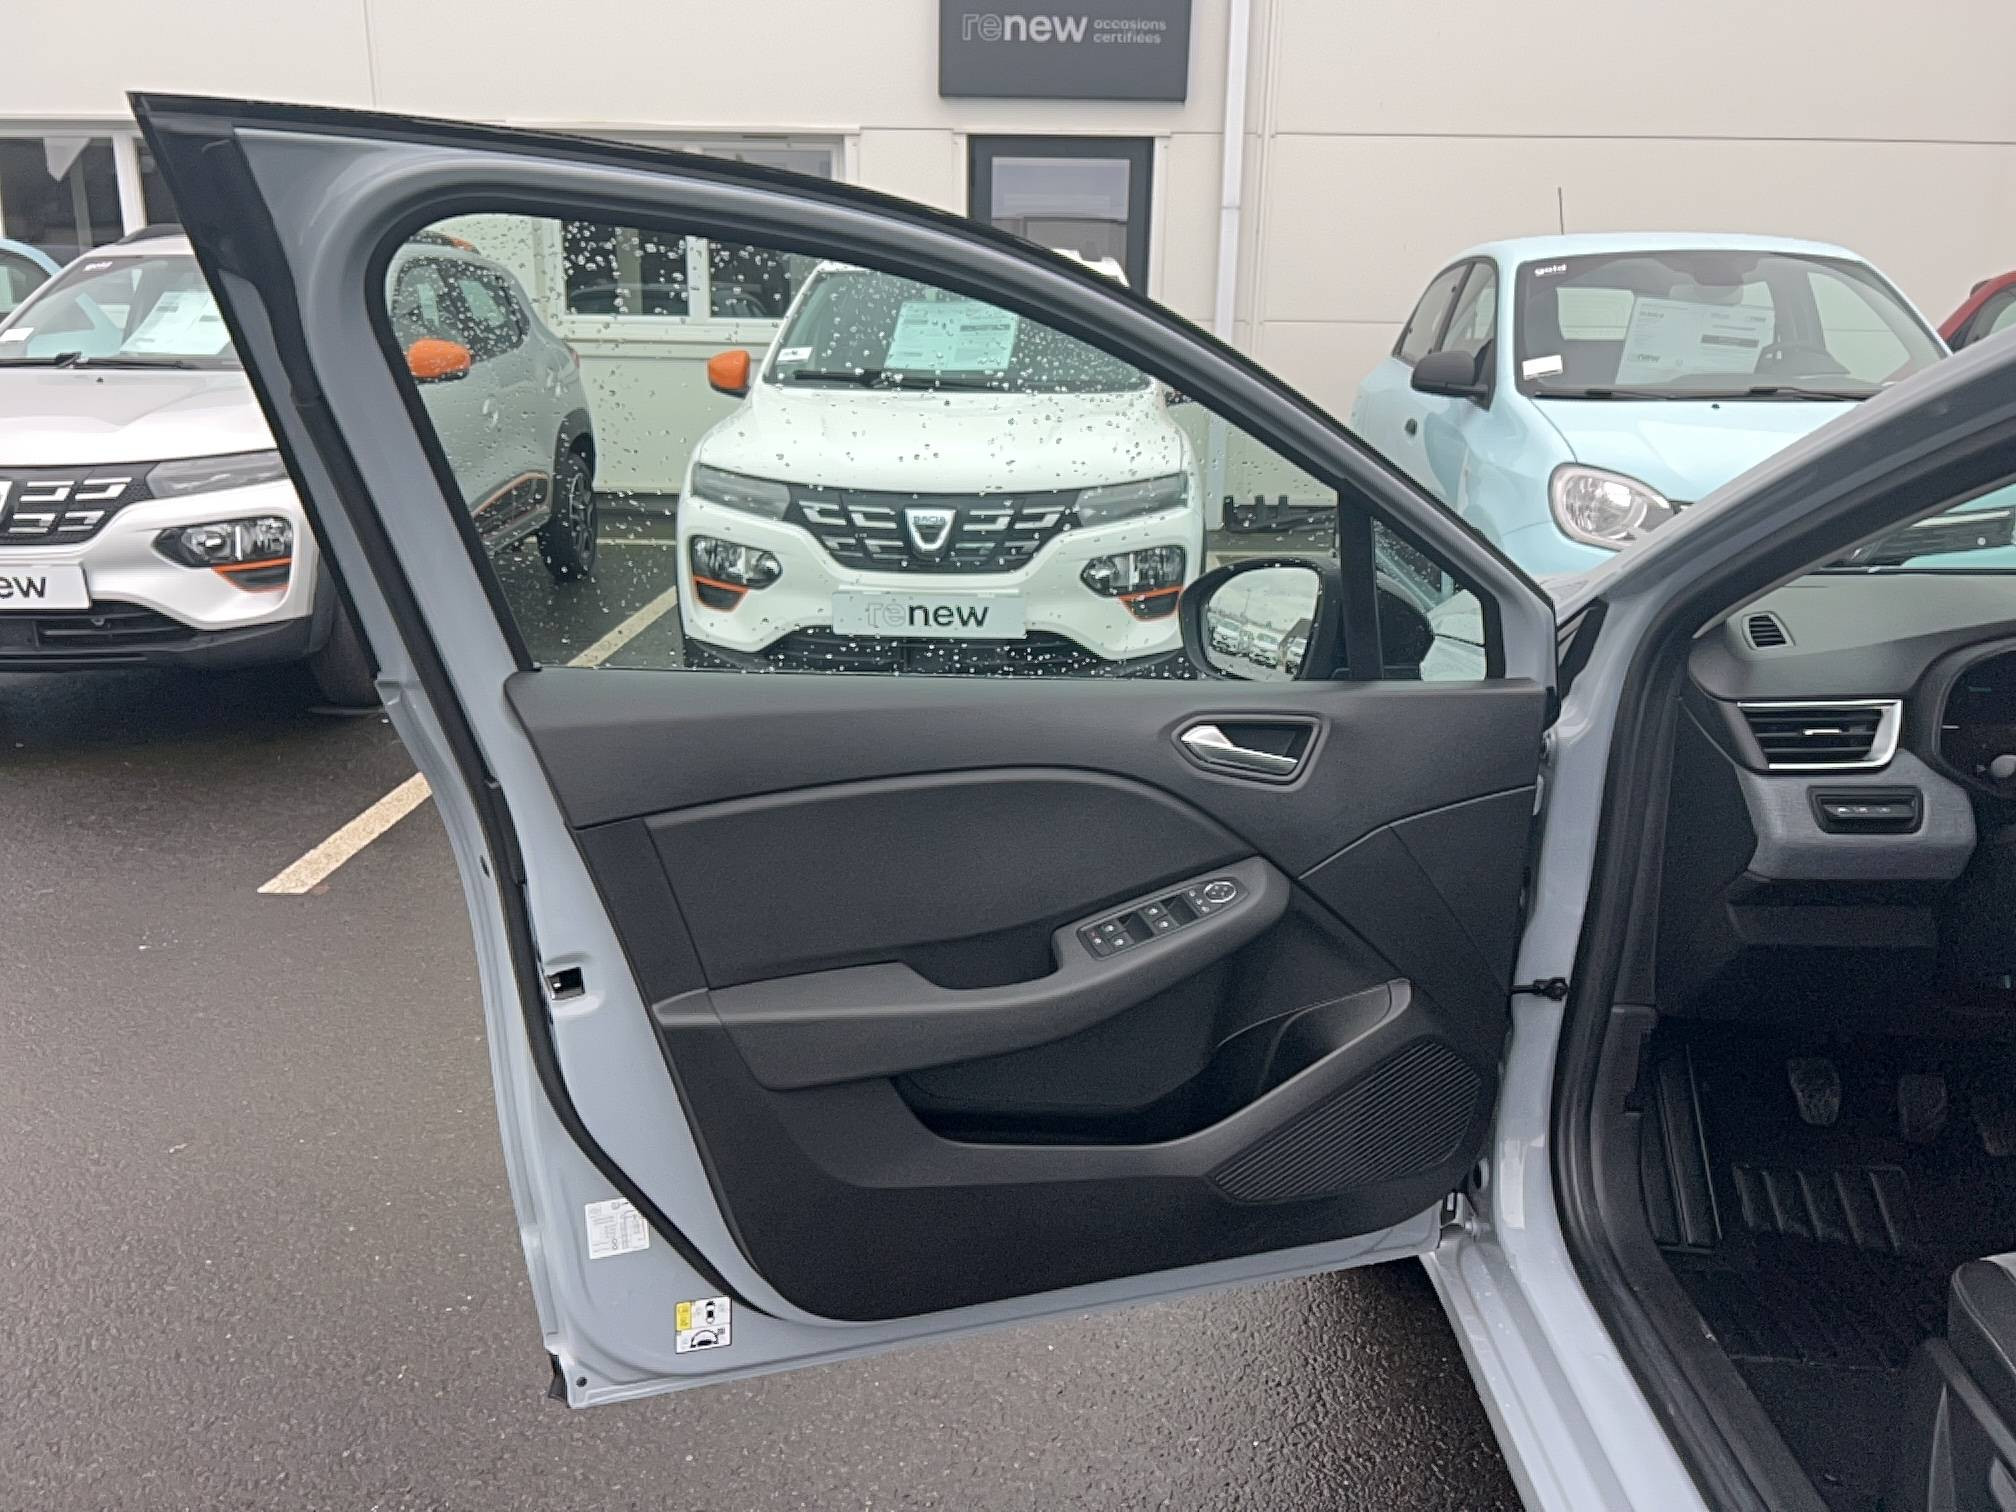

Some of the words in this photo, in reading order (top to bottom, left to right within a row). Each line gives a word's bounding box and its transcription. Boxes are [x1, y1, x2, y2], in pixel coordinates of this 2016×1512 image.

[962, 13, 1088, 43] renew
[1093, 19, 1167, 31] occasions
[866, 603, 989, 627] renew
